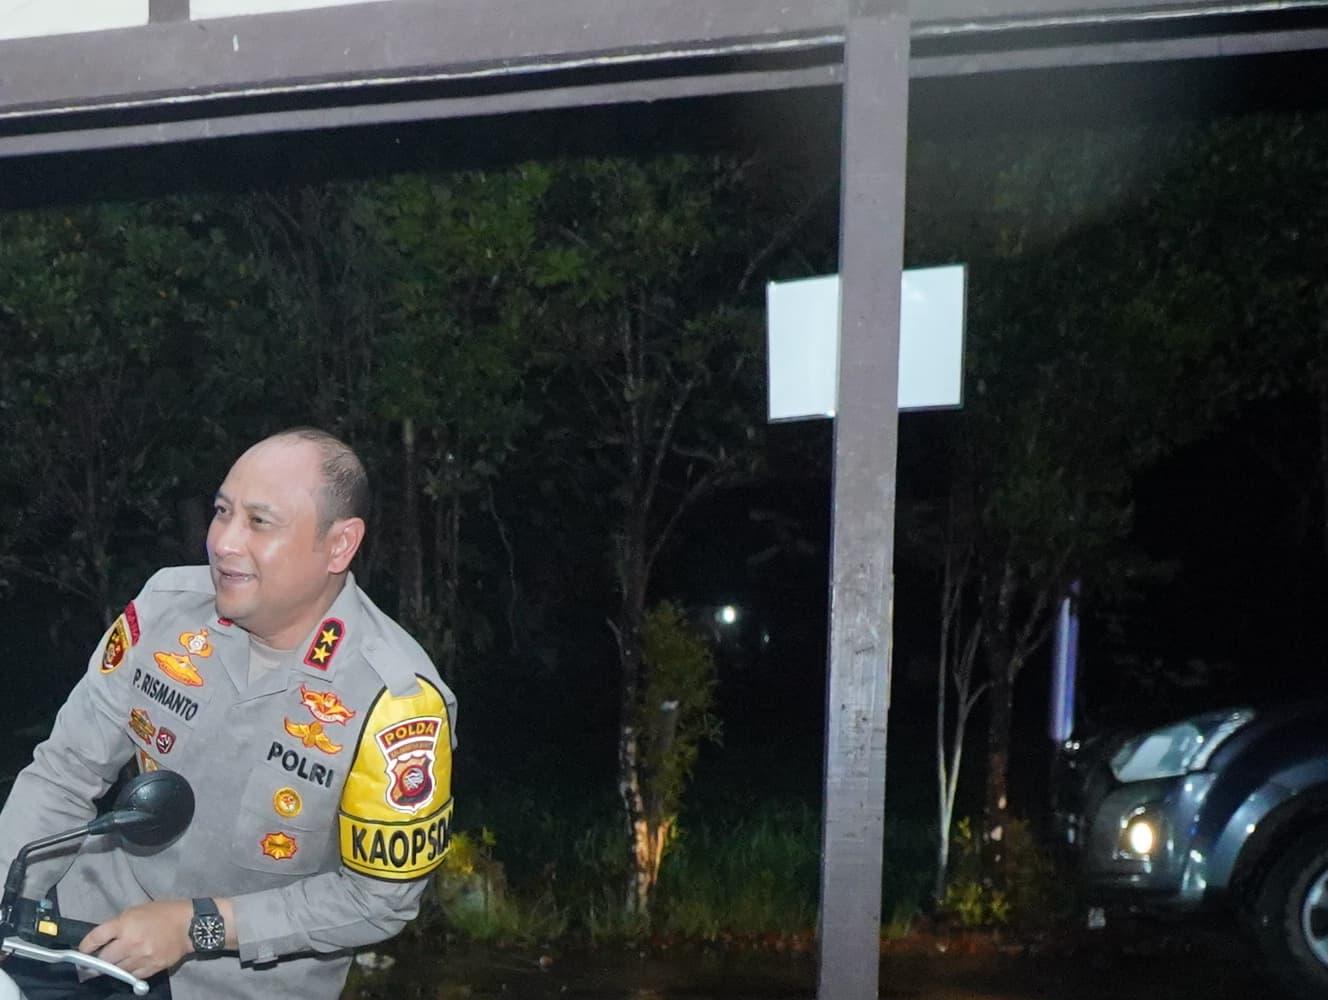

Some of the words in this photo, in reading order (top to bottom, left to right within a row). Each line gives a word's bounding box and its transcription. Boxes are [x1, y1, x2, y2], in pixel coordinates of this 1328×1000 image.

[141, 674, 198, 721] RISMANTO
[384, 722, 435, 747] POLDA
[267, 741, 334, 788] POLRI
